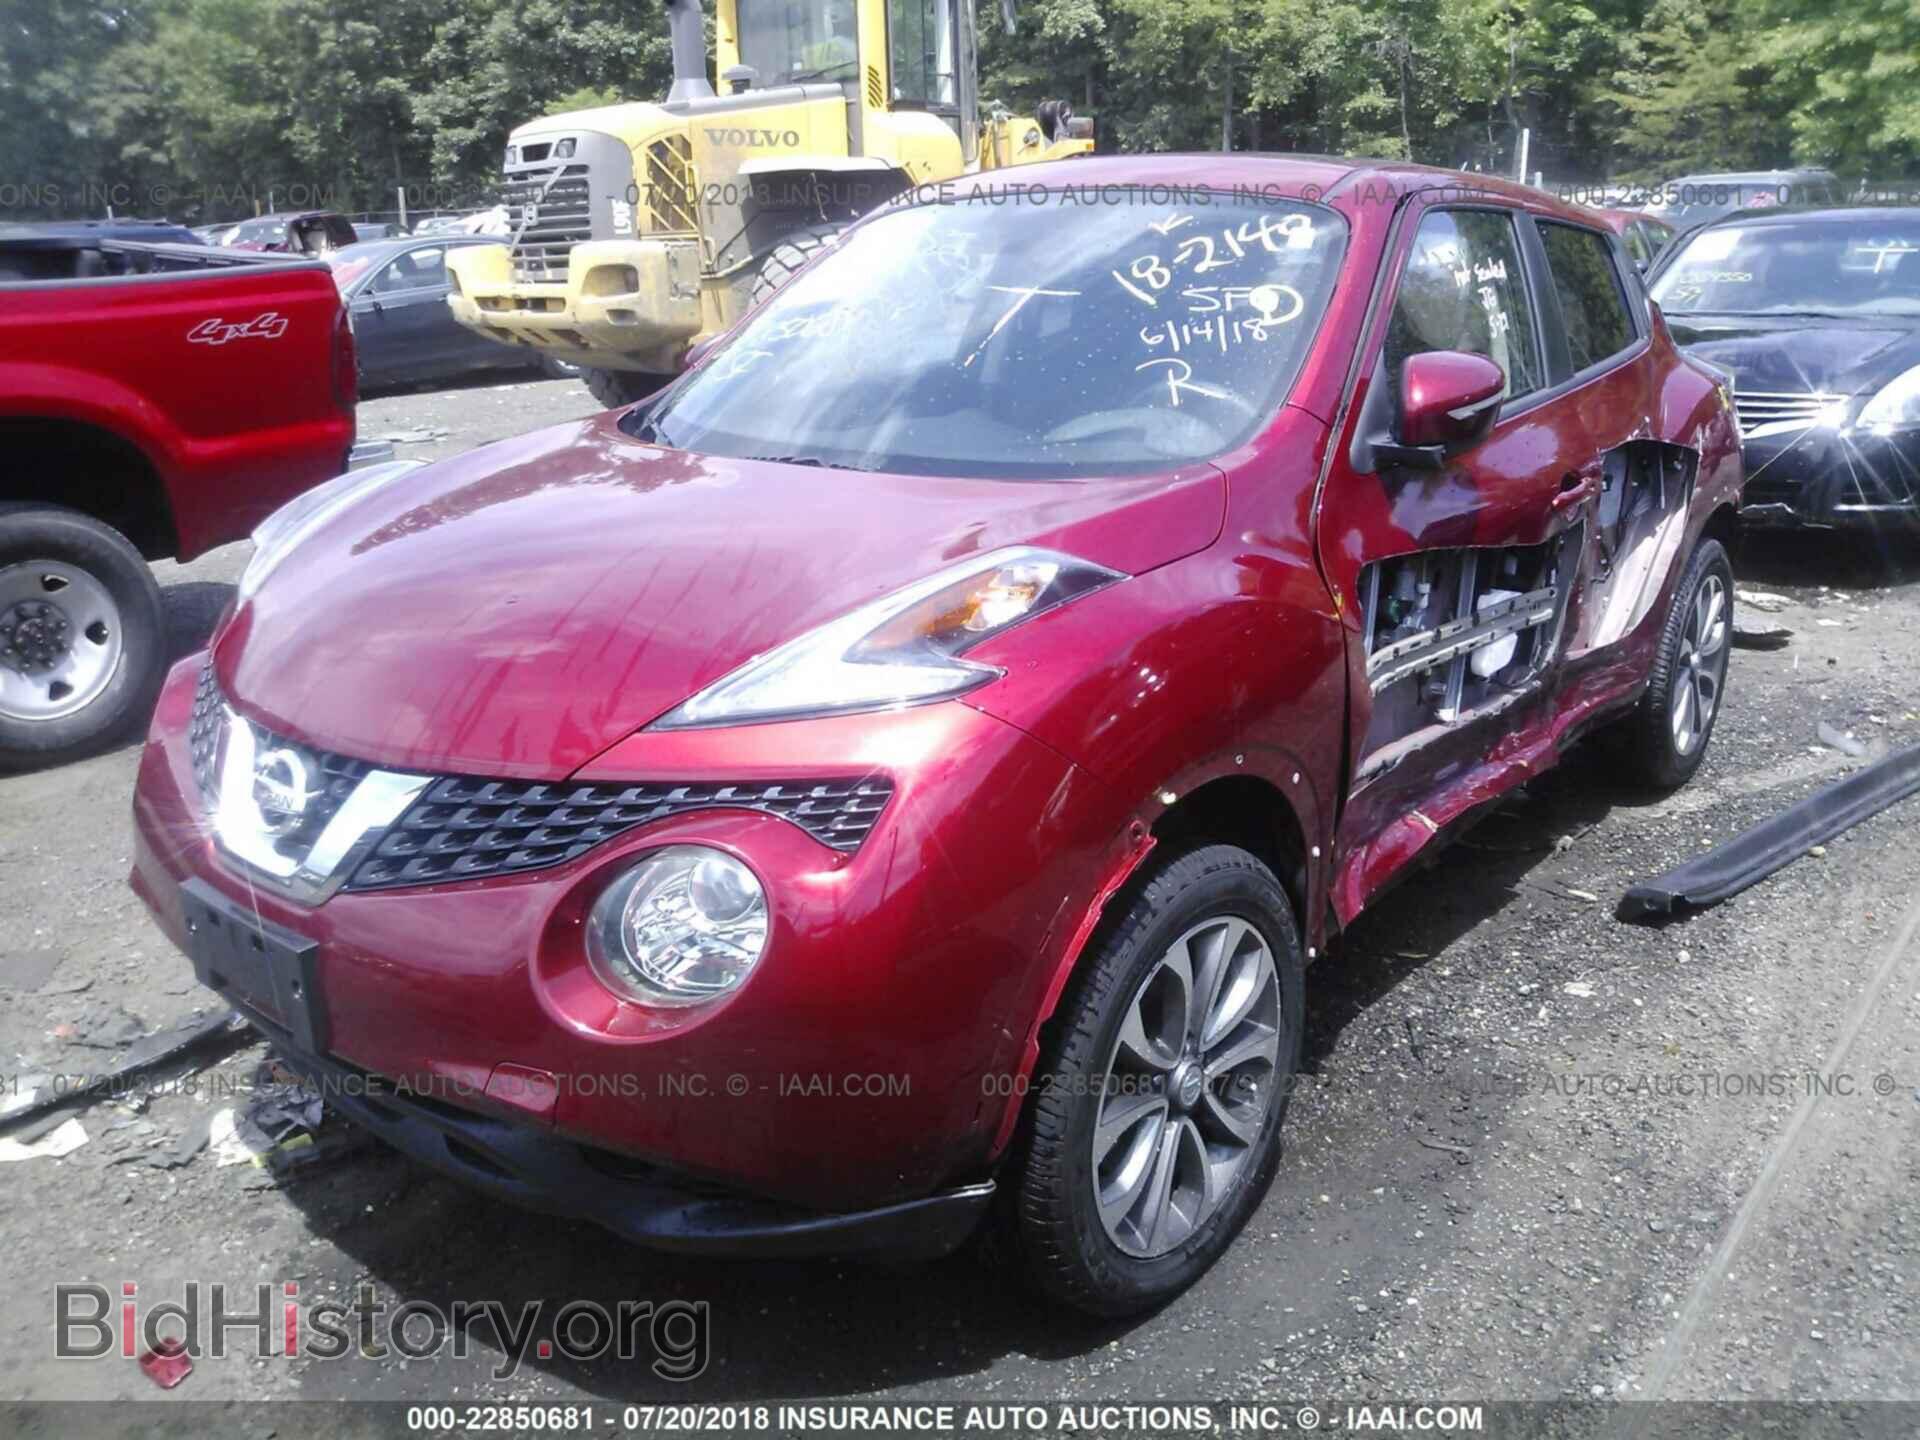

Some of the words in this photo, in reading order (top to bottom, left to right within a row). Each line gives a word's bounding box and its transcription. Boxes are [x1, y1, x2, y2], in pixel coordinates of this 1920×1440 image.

[703, 128, 801, 148] VOLVO
[187, 312, 289, 345] 4x4
[1140, 315, 1268, 352] 6/14/18
